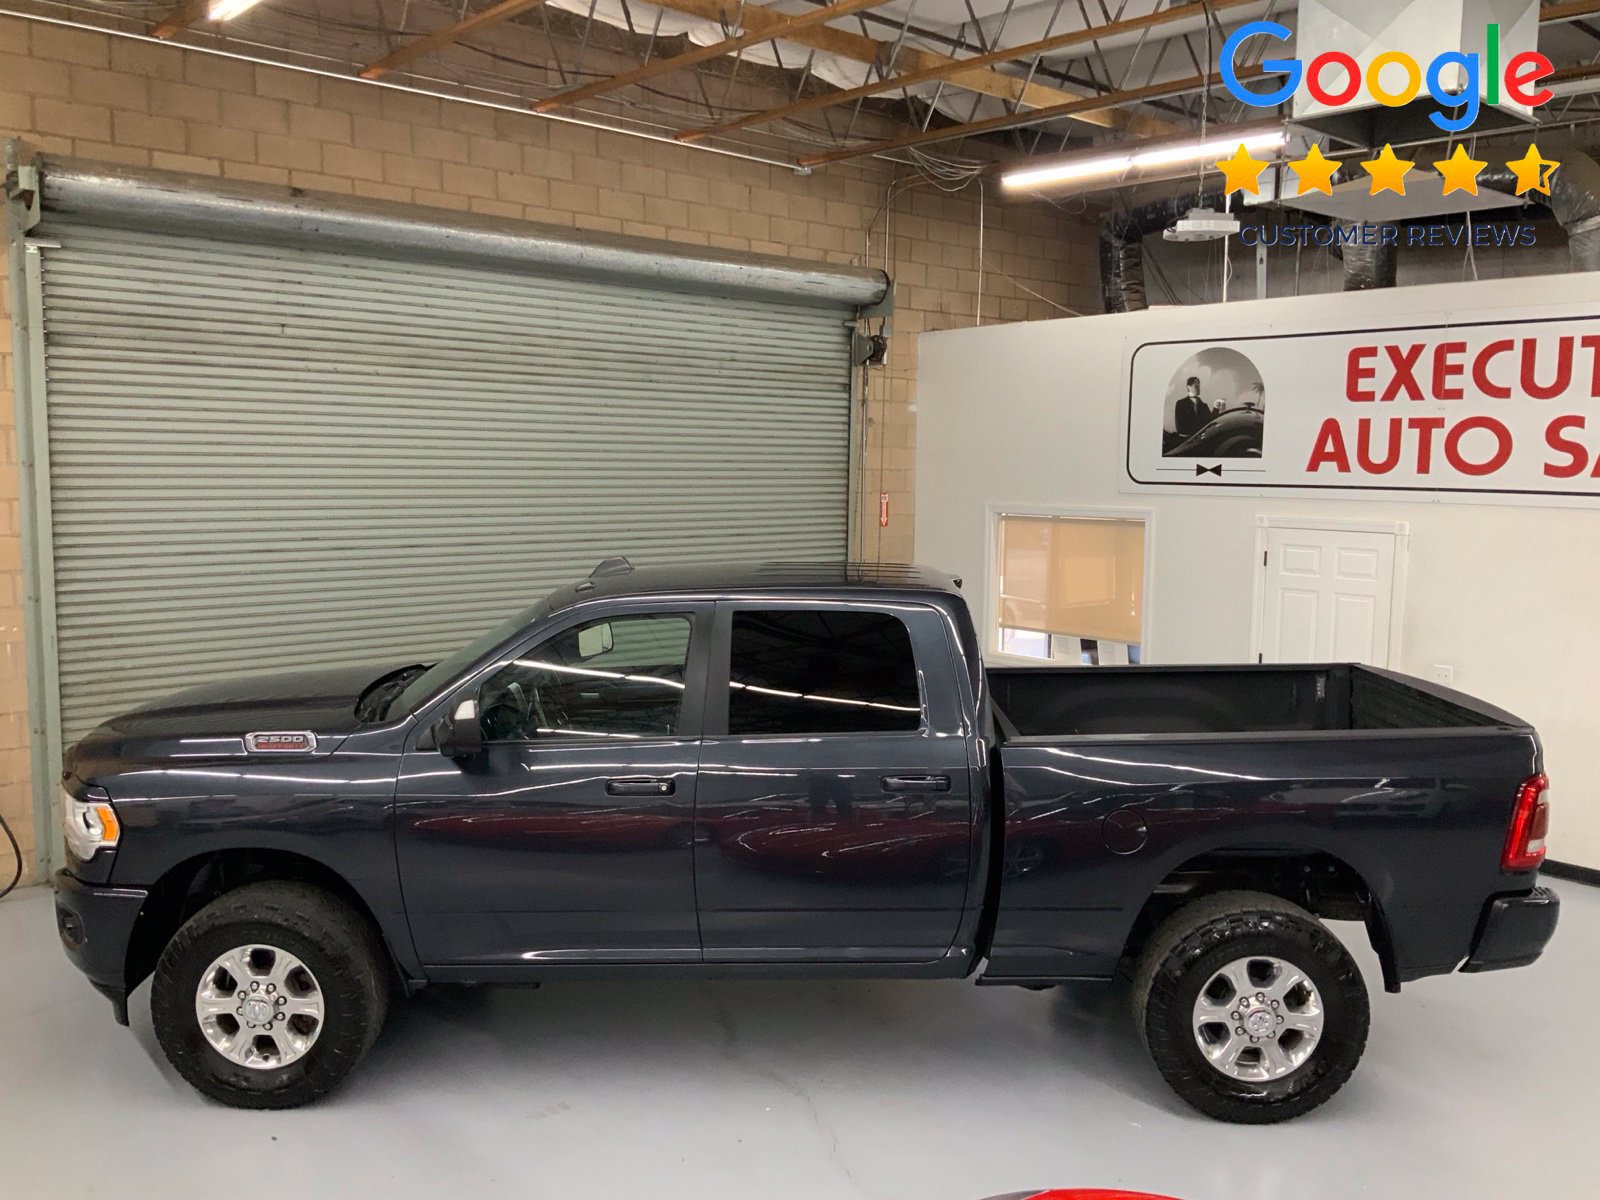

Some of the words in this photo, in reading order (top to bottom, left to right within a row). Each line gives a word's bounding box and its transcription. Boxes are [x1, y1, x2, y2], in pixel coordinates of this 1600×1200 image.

[1306, 416, 1513, 476] AUTO
[1543, 415, 1600, 478] S
[257, 735, 304, 743] 2500
